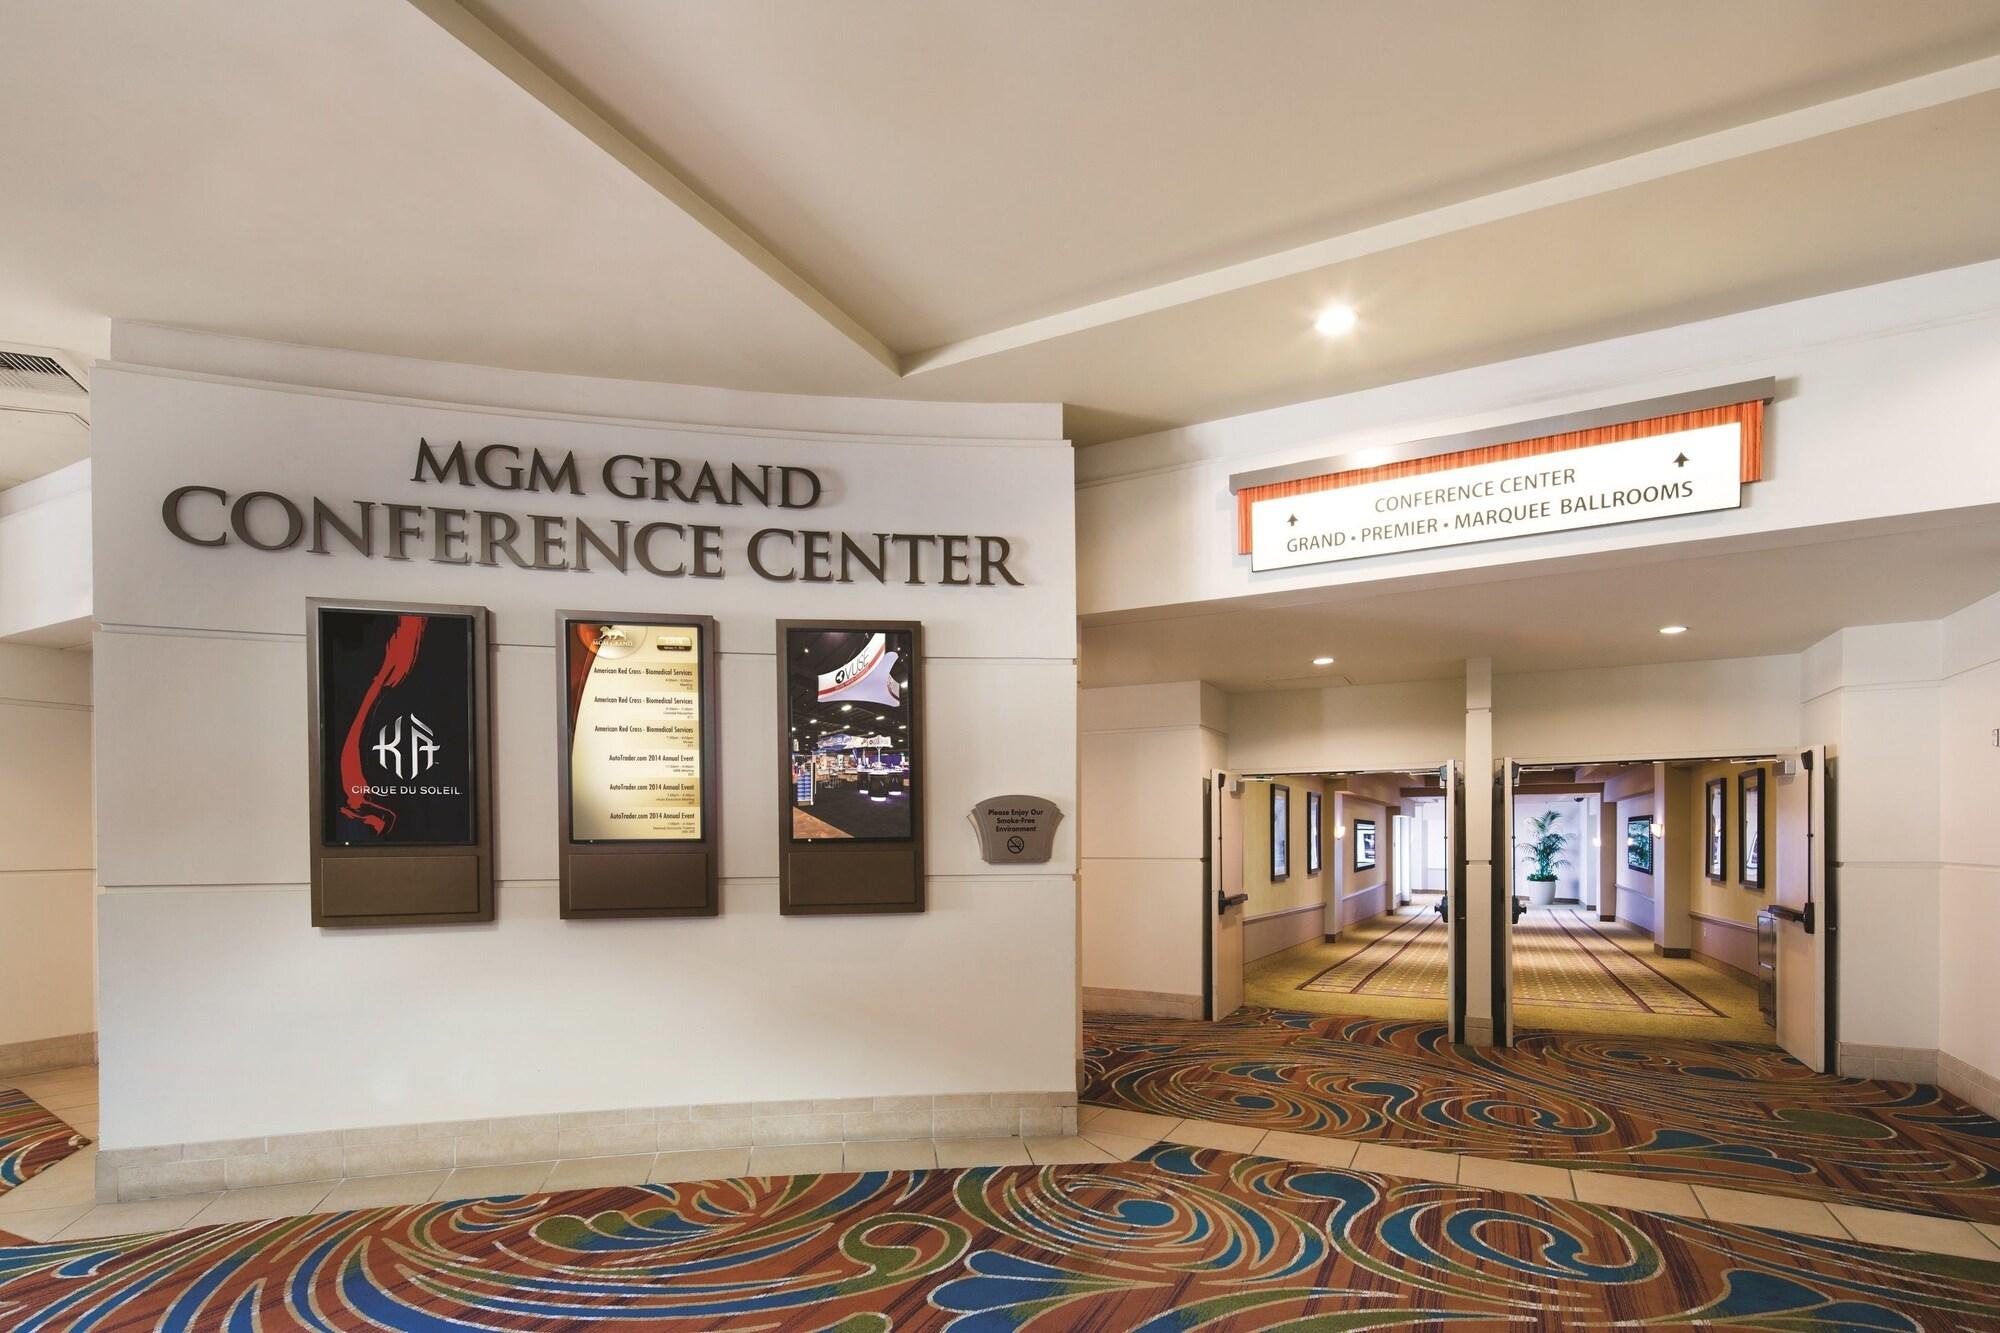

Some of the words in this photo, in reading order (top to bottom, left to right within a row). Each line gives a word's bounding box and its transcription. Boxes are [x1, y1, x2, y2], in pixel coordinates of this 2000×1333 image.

[410, 437, 586, 496] MGM
[602, 454, 822, 510] GRAND
[1375, 480, 1495, 513] CONFERENCE
[1500, 468, 1576, 494] CENTER
[1286, 532, 1346, 553] GRAND
[1361, 517, 1439, 543] PREMIER
[1454, 501, 1552, 530] MARQUEE
[1560, 479, 1694, 515] BALLROOMS
[162, 485, 725, 578] CONFERENCE
[747, 528, 1024, 587] CENTER
[628, 667, 641, 675] Cross
[673, 668, 692, 676] Services
[629, 696, 642, 704] Cross
[673, 697, 693, 705] Services
[630, 725, 642, 733] Cross
[674, 726, 693, 734] Services
[681, 754, 693, 762] Event
[400, 786, 416, 795] DU
[420, 786, 460, 795] SOLEIL
[681, 783, 694, 791] Event
[682, 812, 694, 820] Event
[1011, 809, 1029, 817] Enjoy
